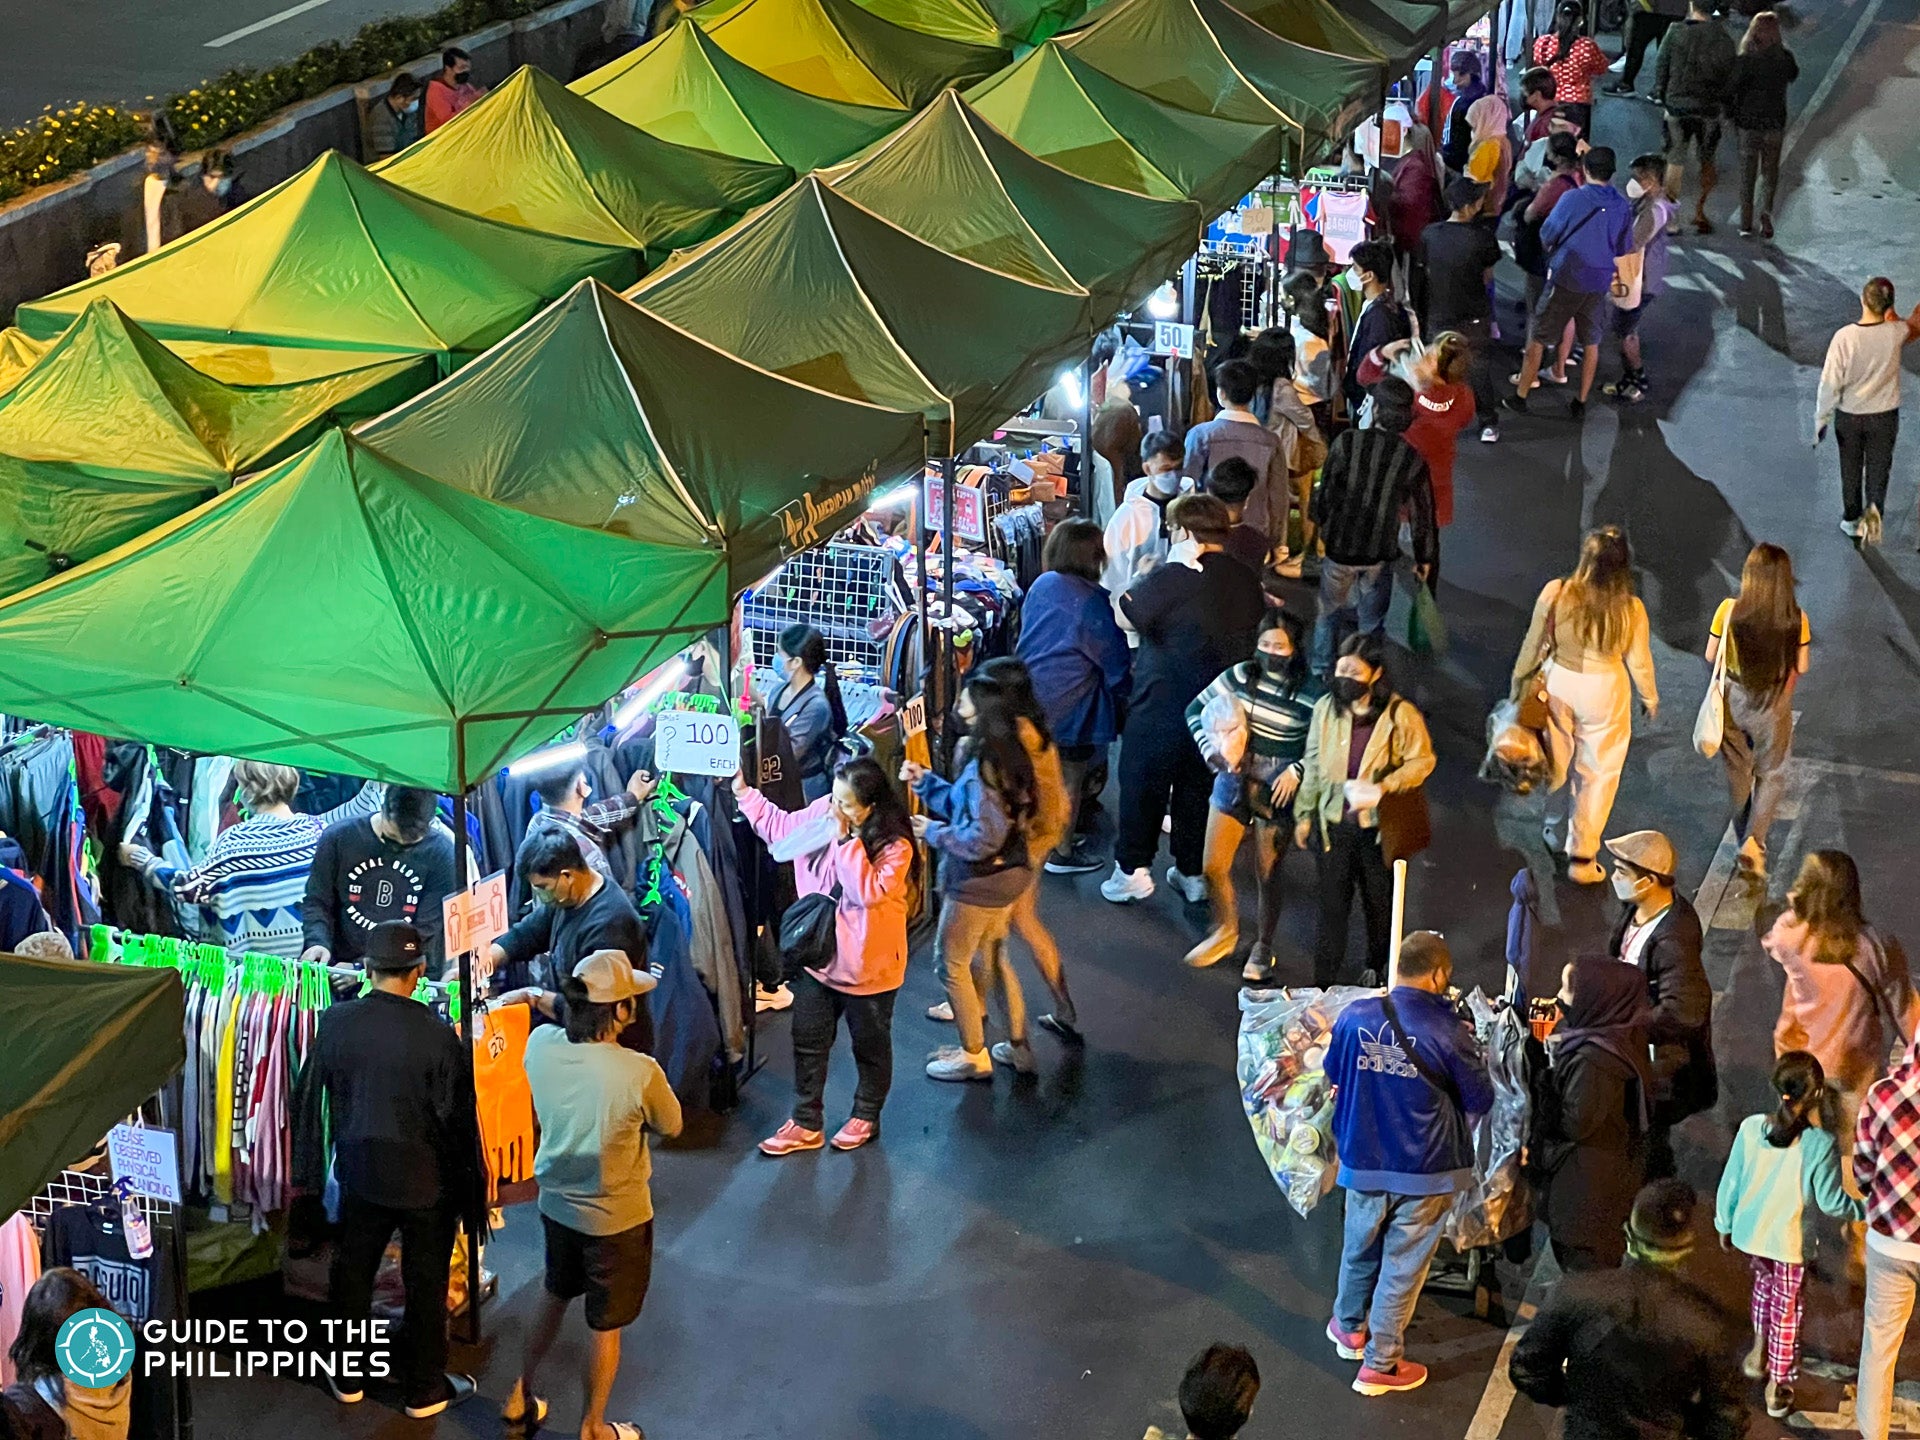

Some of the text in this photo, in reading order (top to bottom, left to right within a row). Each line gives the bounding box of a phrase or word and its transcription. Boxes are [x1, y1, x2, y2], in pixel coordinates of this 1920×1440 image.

[1161, 325, 1182, 348] 50
[686, 723, 729, 744] 100
[710, 758, 736, 769] EACH
[760, 754, 782, 784] 92
[348, 857, 423, 891] ROYAL BLOOD
[376, 879, 394, 907] B
[1357, 1054, 1418, 1078] adidas
[117, 1158, 161, 1180] PHYSICAL
